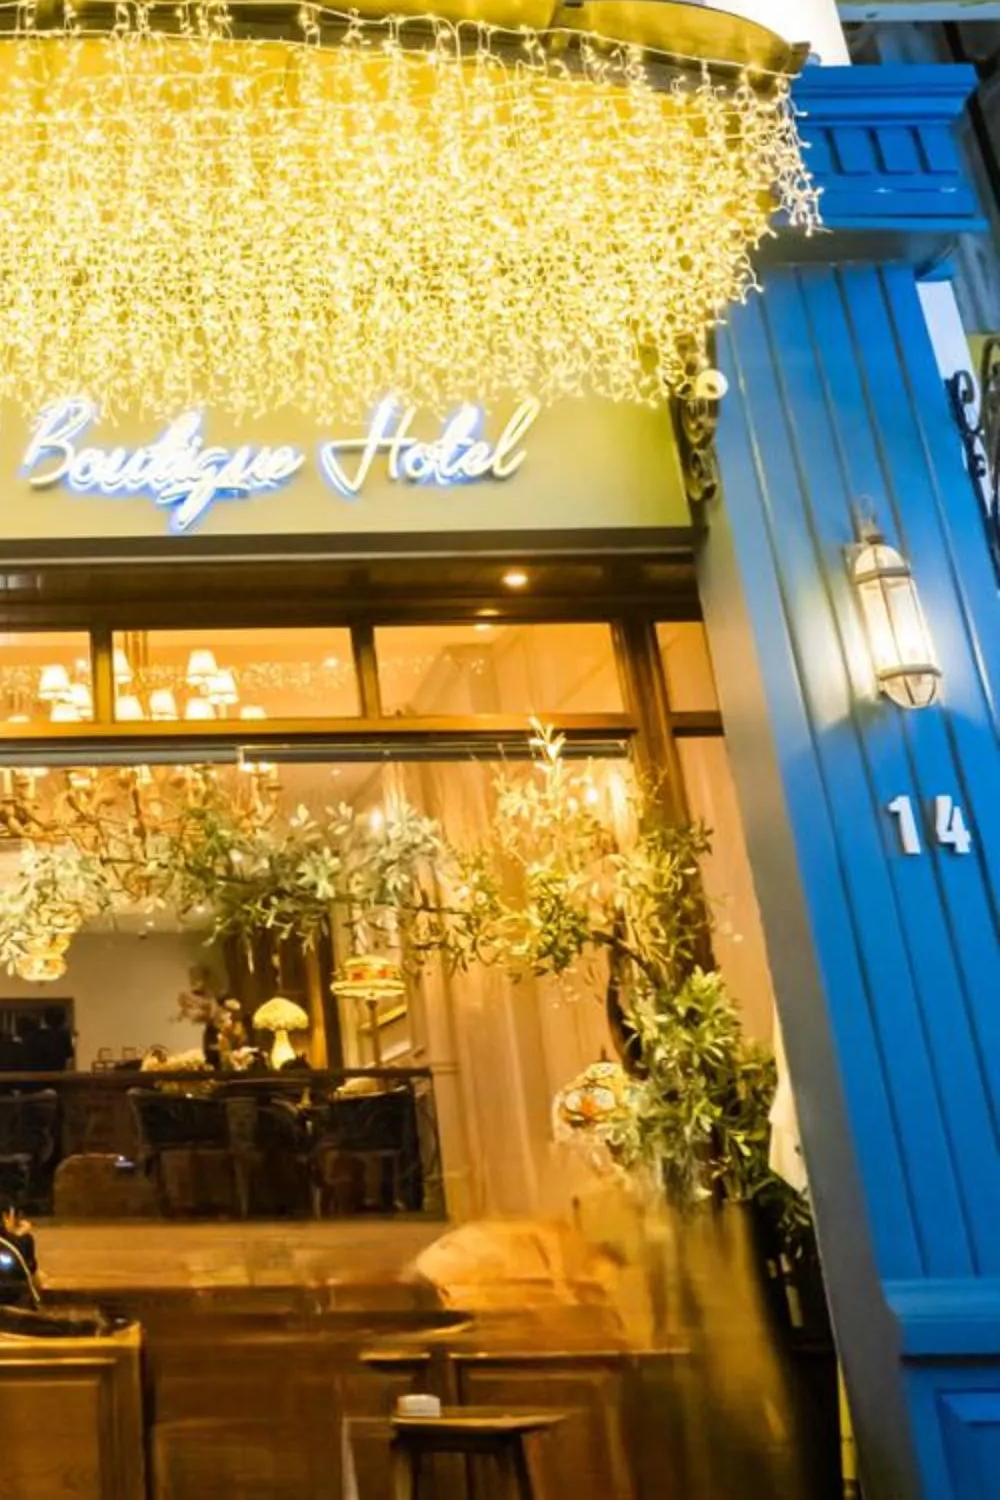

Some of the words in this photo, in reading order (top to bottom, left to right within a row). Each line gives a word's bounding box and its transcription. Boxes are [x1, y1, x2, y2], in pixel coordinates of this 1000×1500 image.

[22, 395, 306, 531] Boutique
[319, 392, 541, 497] Hotel
[888, 795, 971, 854] 14
